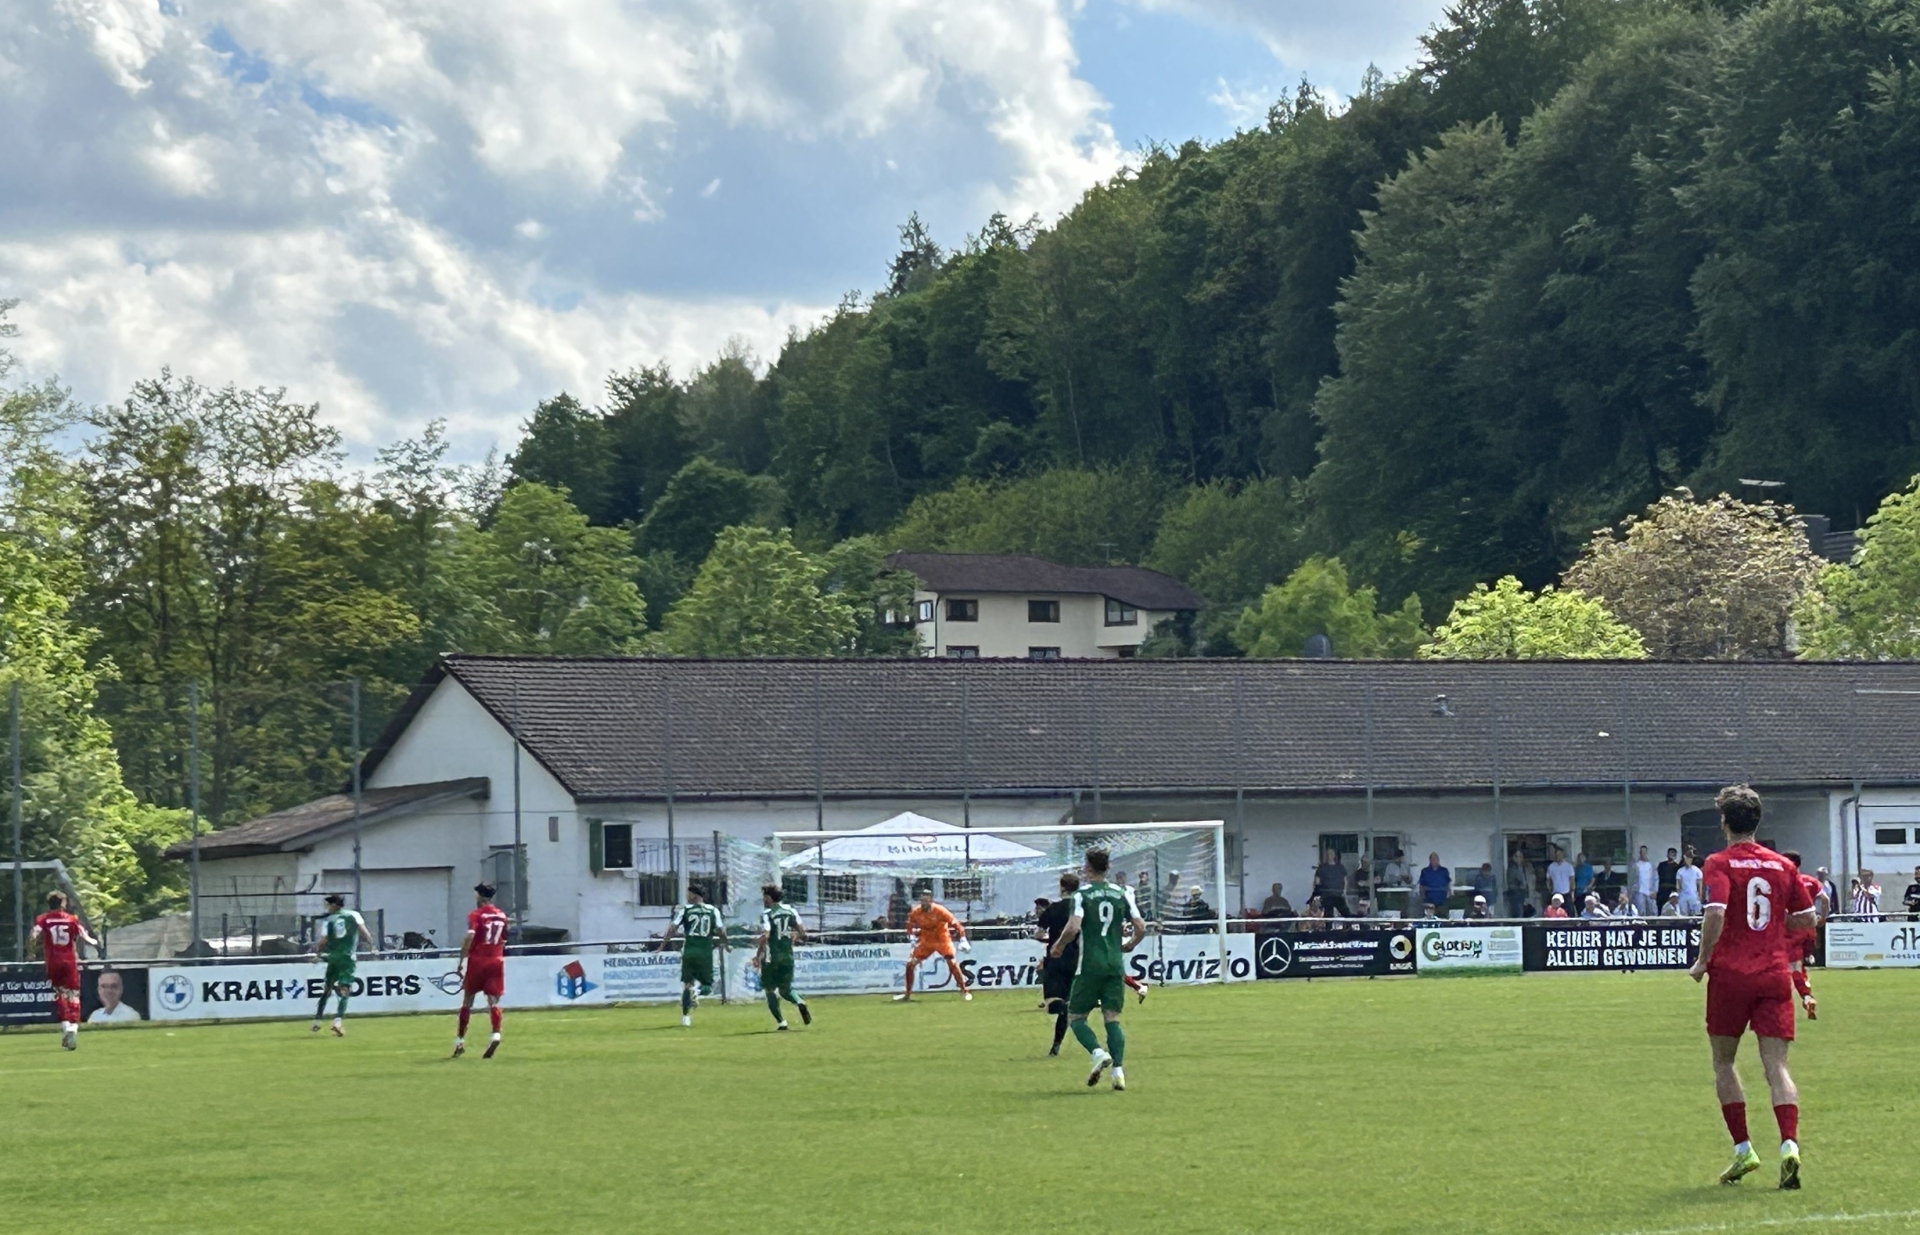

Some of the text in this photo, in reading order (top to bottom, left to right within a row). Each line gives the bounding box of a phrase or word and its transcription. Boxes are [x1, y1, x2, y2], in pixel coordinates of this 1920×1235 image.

[1747, 876, 1772, 931] 6
[688, 913, 711, 938] 20
[1098, 900, 1114, 937] 9
[50, 925, 70, 946] 15
[485, 920, 505, 946] 17
[1546, 930, 1602, 948] KEINER
[1605, 930, 1635, 948] HAT
[1638, 929, 1657, 946] JE
[1661, 929, 1687, 946] EIN
[1546, 948, 1688, 966] ALLEIN GEWONNEN
[202, 979, 284, 1002] KRAH
[306, 974, 421, 999] EDERS
